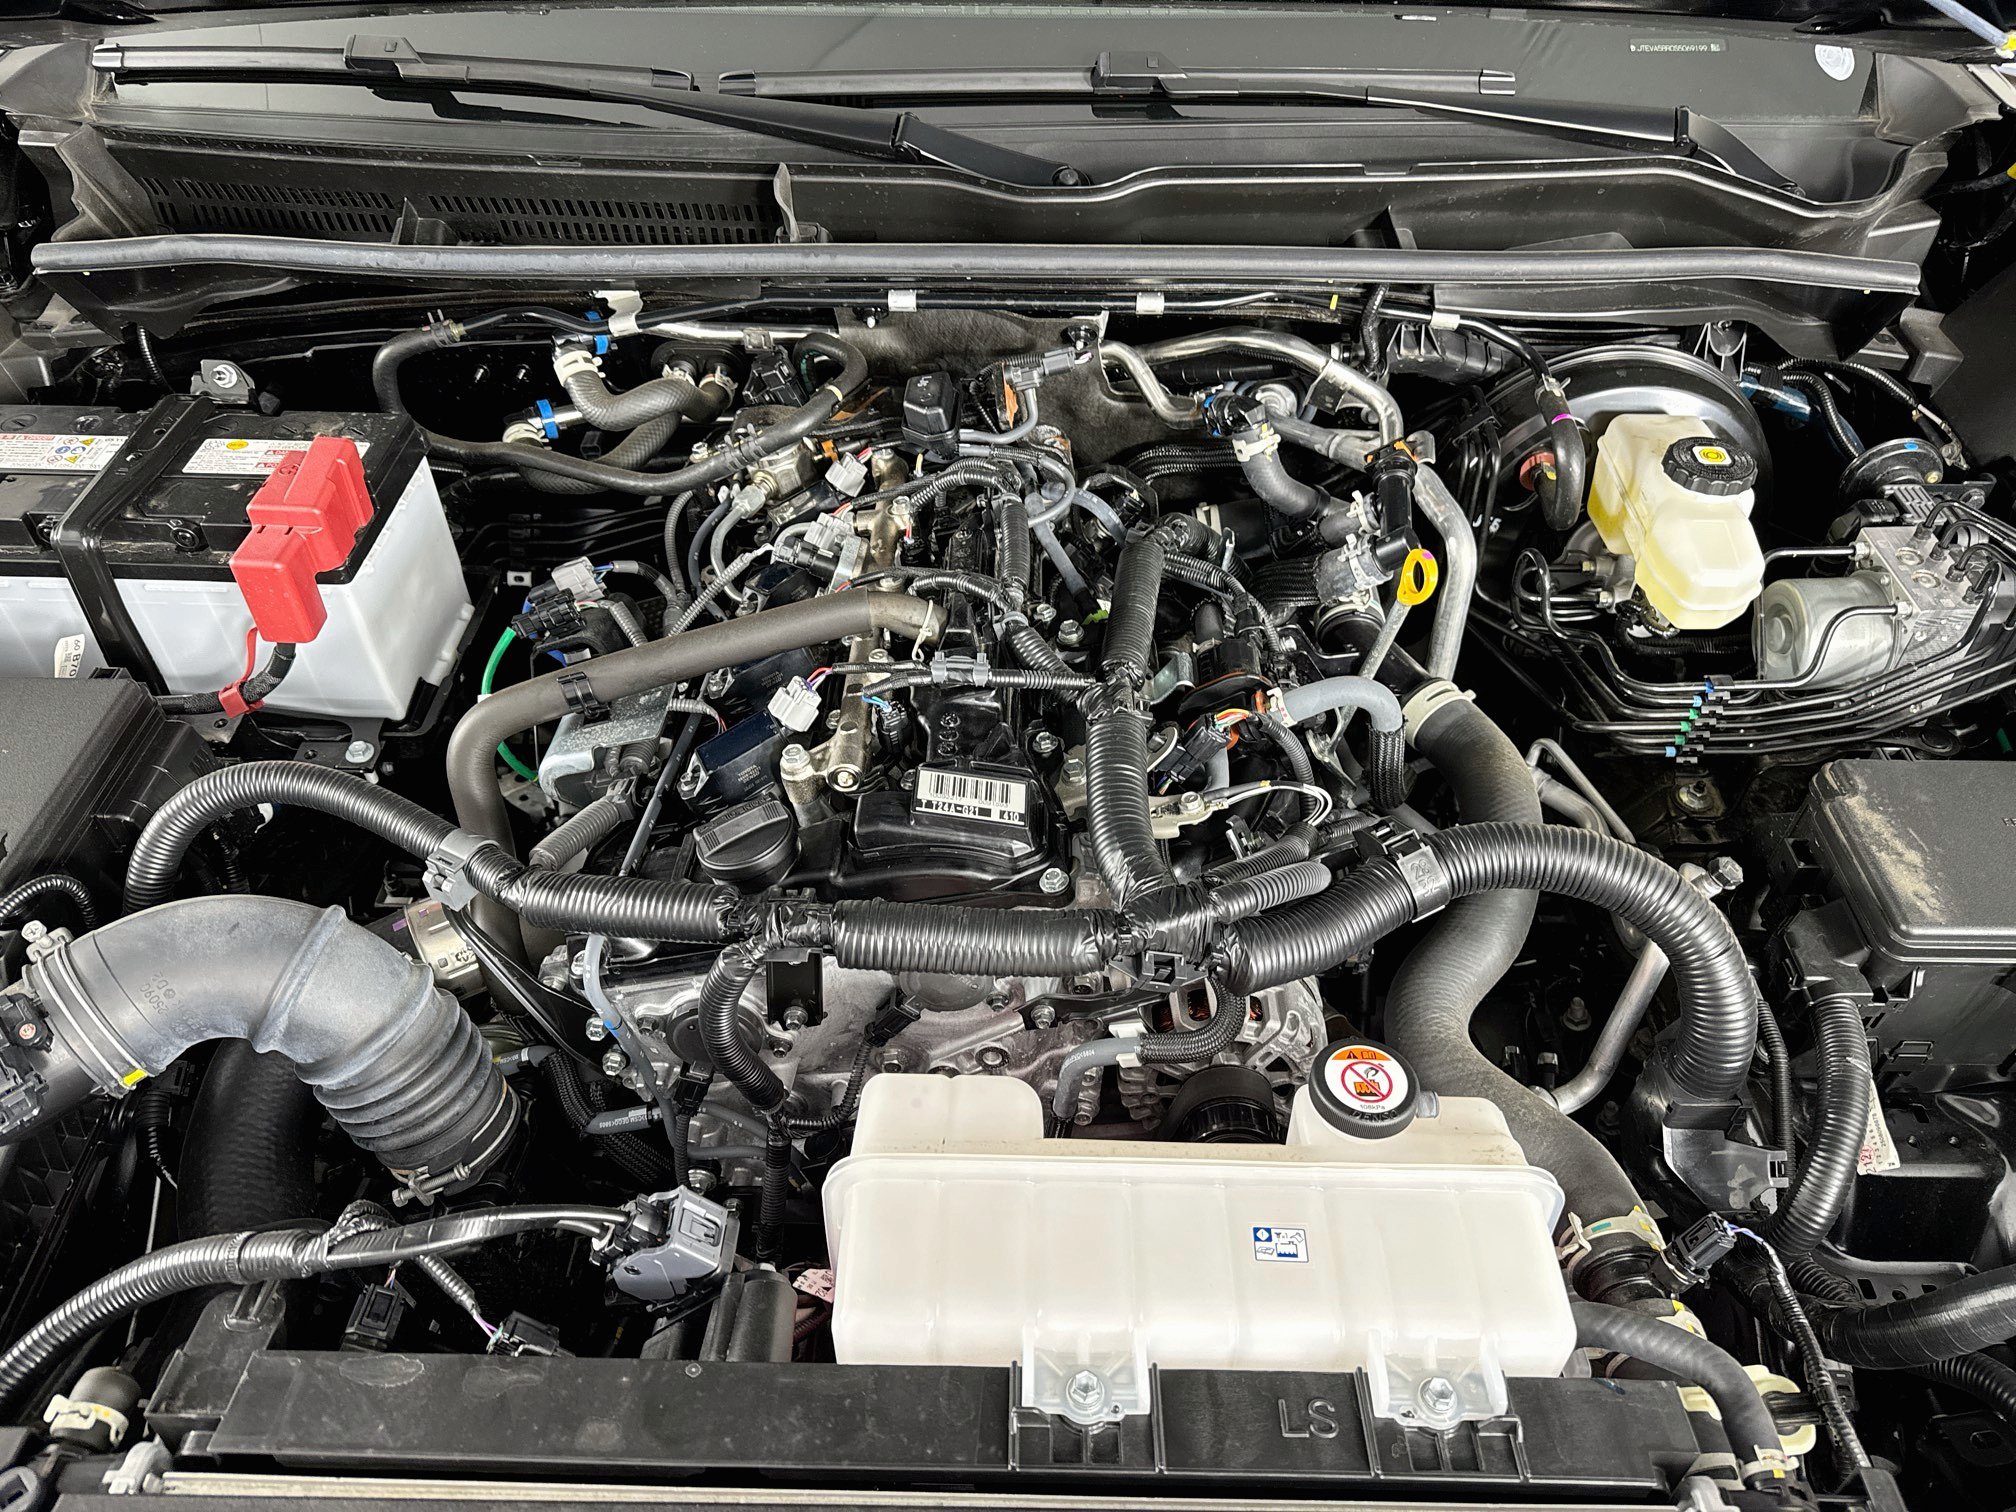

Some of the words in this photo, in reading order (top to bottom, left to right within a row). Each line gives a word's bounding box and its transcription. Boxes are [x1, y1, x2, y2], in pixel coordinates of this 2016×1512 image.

[921, 799, 928, 809] T
[932, 801, 979, 817] T24A-G21
[1003, 810, 1020, 821] 410
[1350, 1109, 1398, 1122] DENSO
[1277, 1398, 1340, 1439] LS
